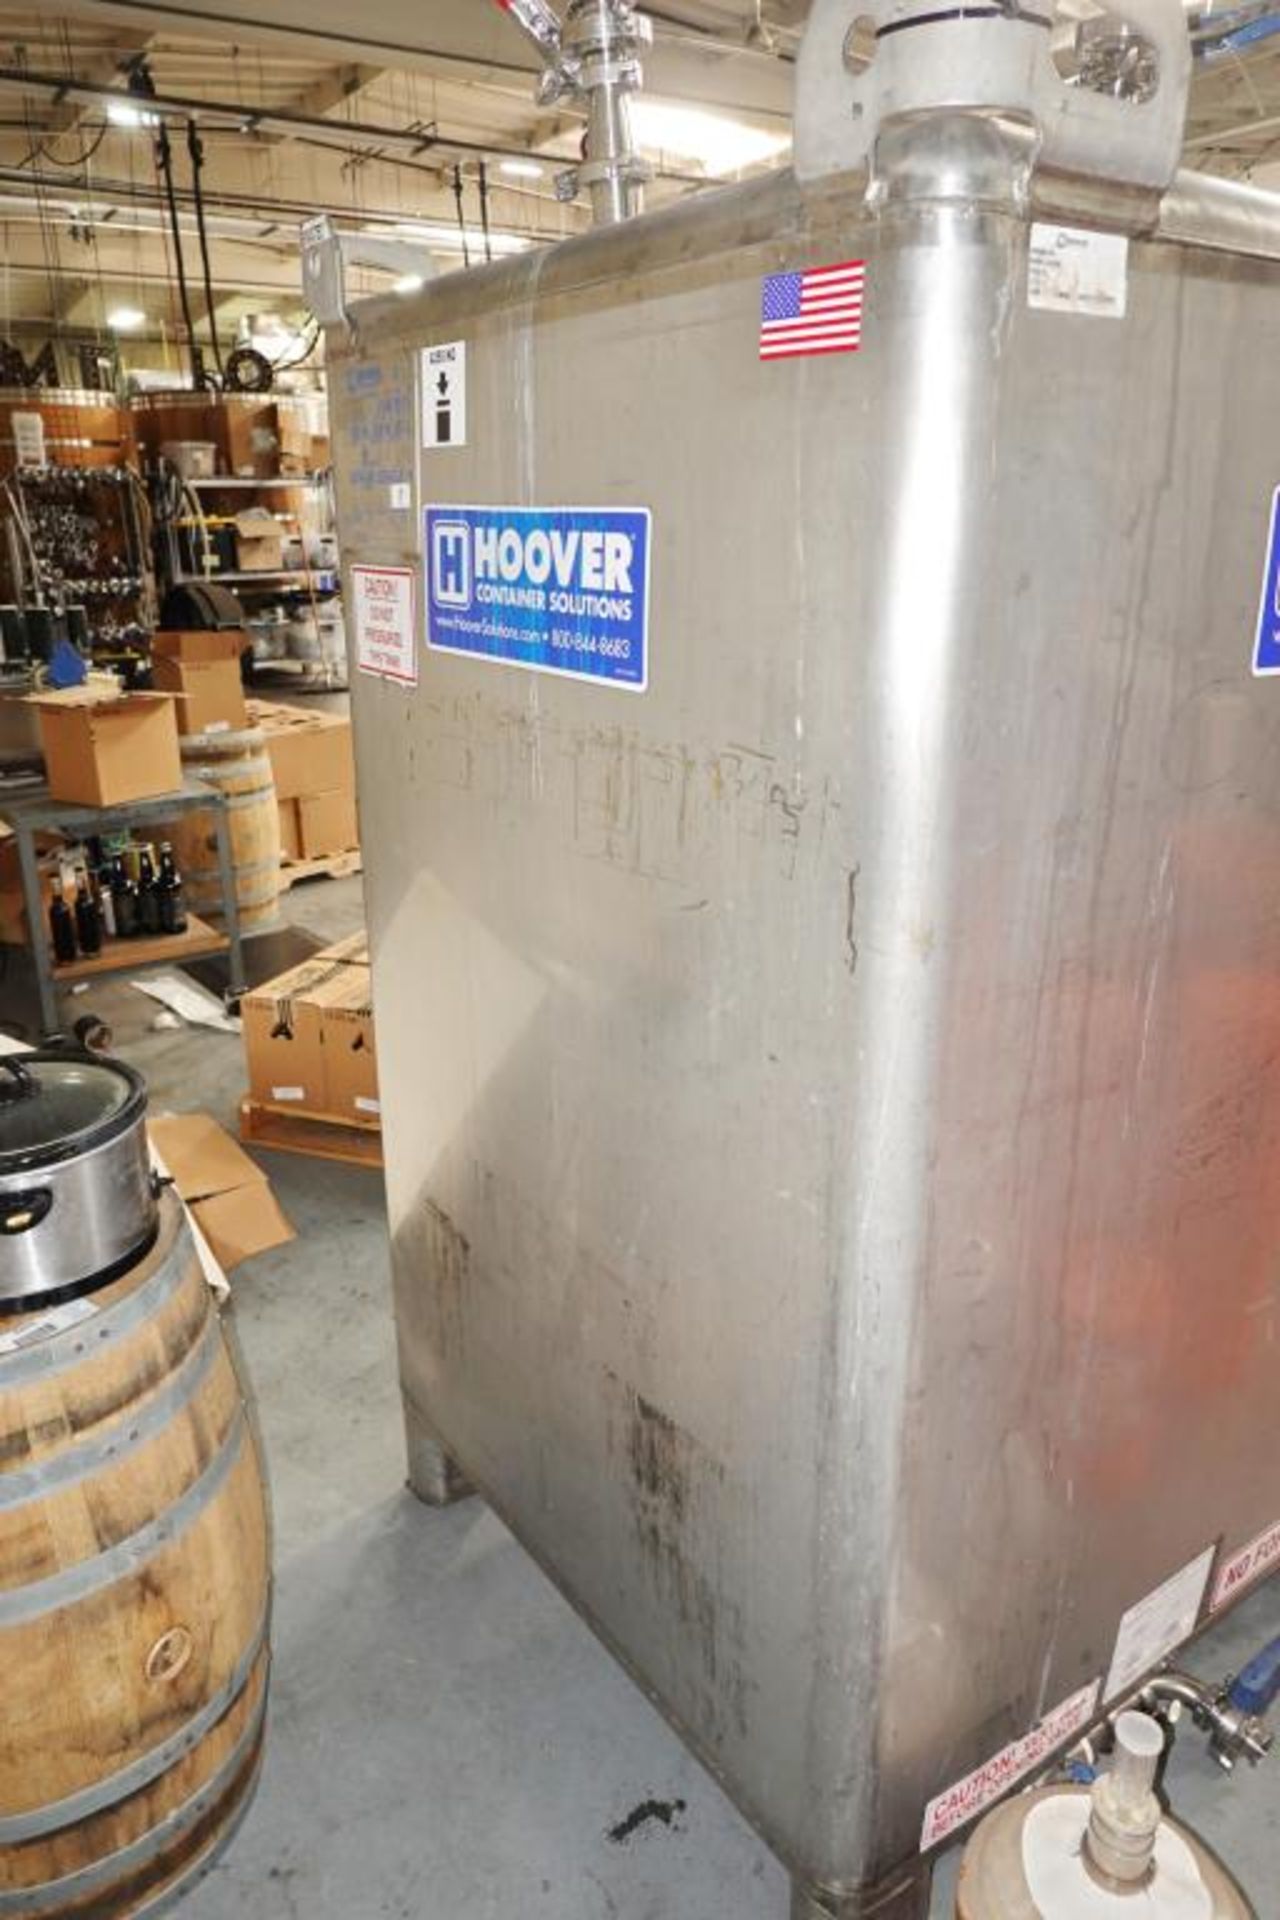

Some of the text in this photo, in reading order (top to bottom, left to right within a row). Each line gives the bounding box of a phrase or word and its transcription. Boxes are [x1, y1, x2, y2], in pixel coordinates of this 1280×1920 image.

[474, 526, 634, 593] HOOVER
[476, 583, 632, 620] CONTAINER SOLUTIONS
[552, 629, 630, 659] 800-844-8683
